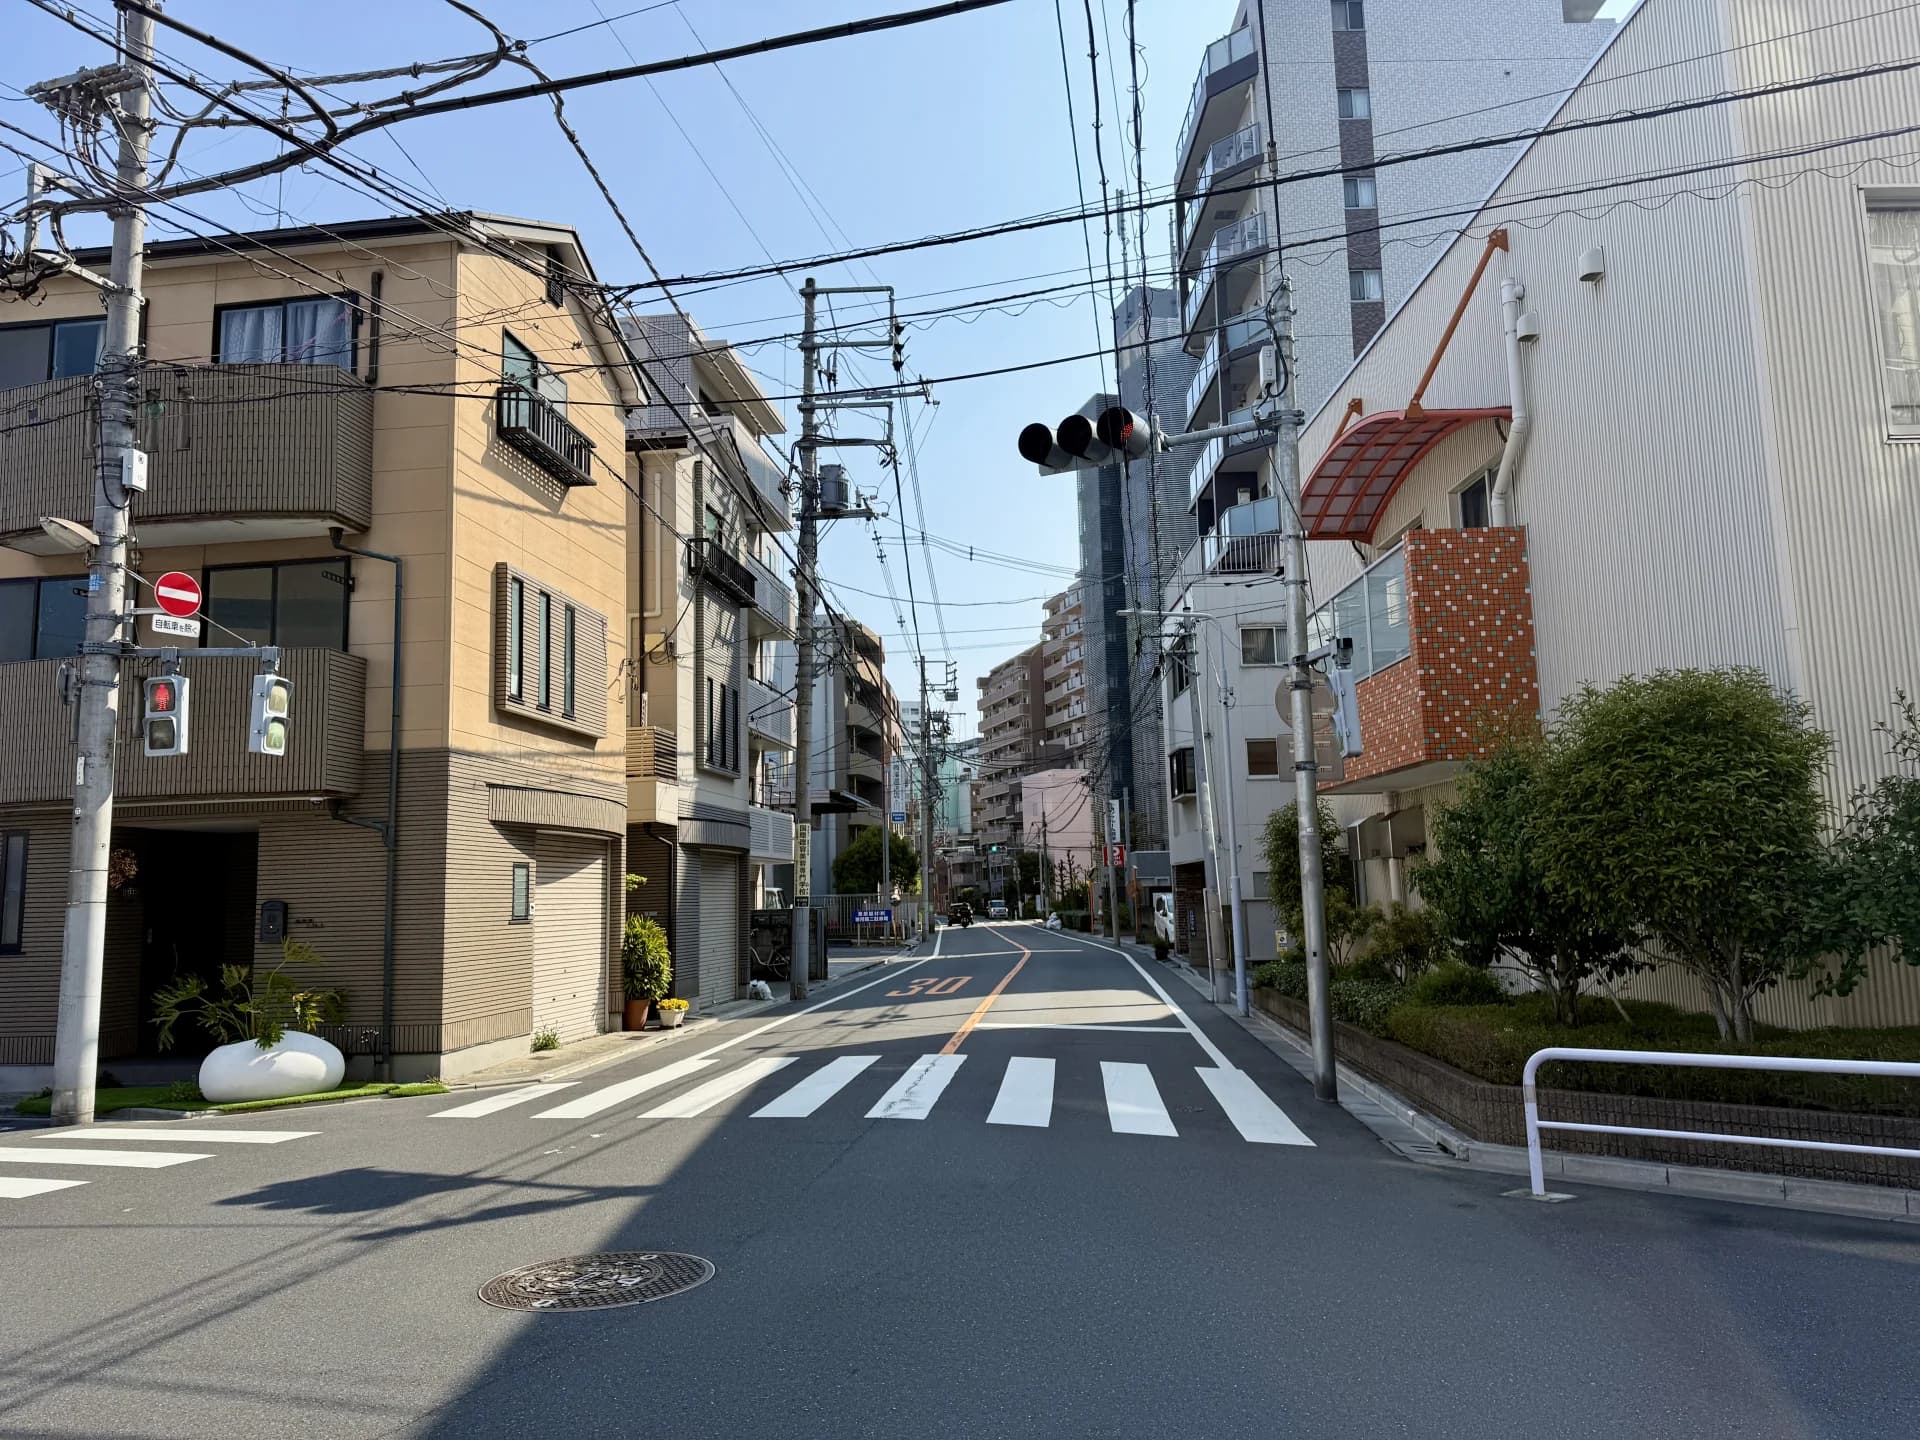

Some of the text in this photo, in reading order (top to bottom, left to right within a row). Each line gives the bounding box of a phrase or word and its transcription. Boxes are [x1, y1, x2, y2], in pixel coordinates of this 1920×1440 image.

[155, 619, 197, 634] 自転車を除く
[885, 976, 973, 996] 30
